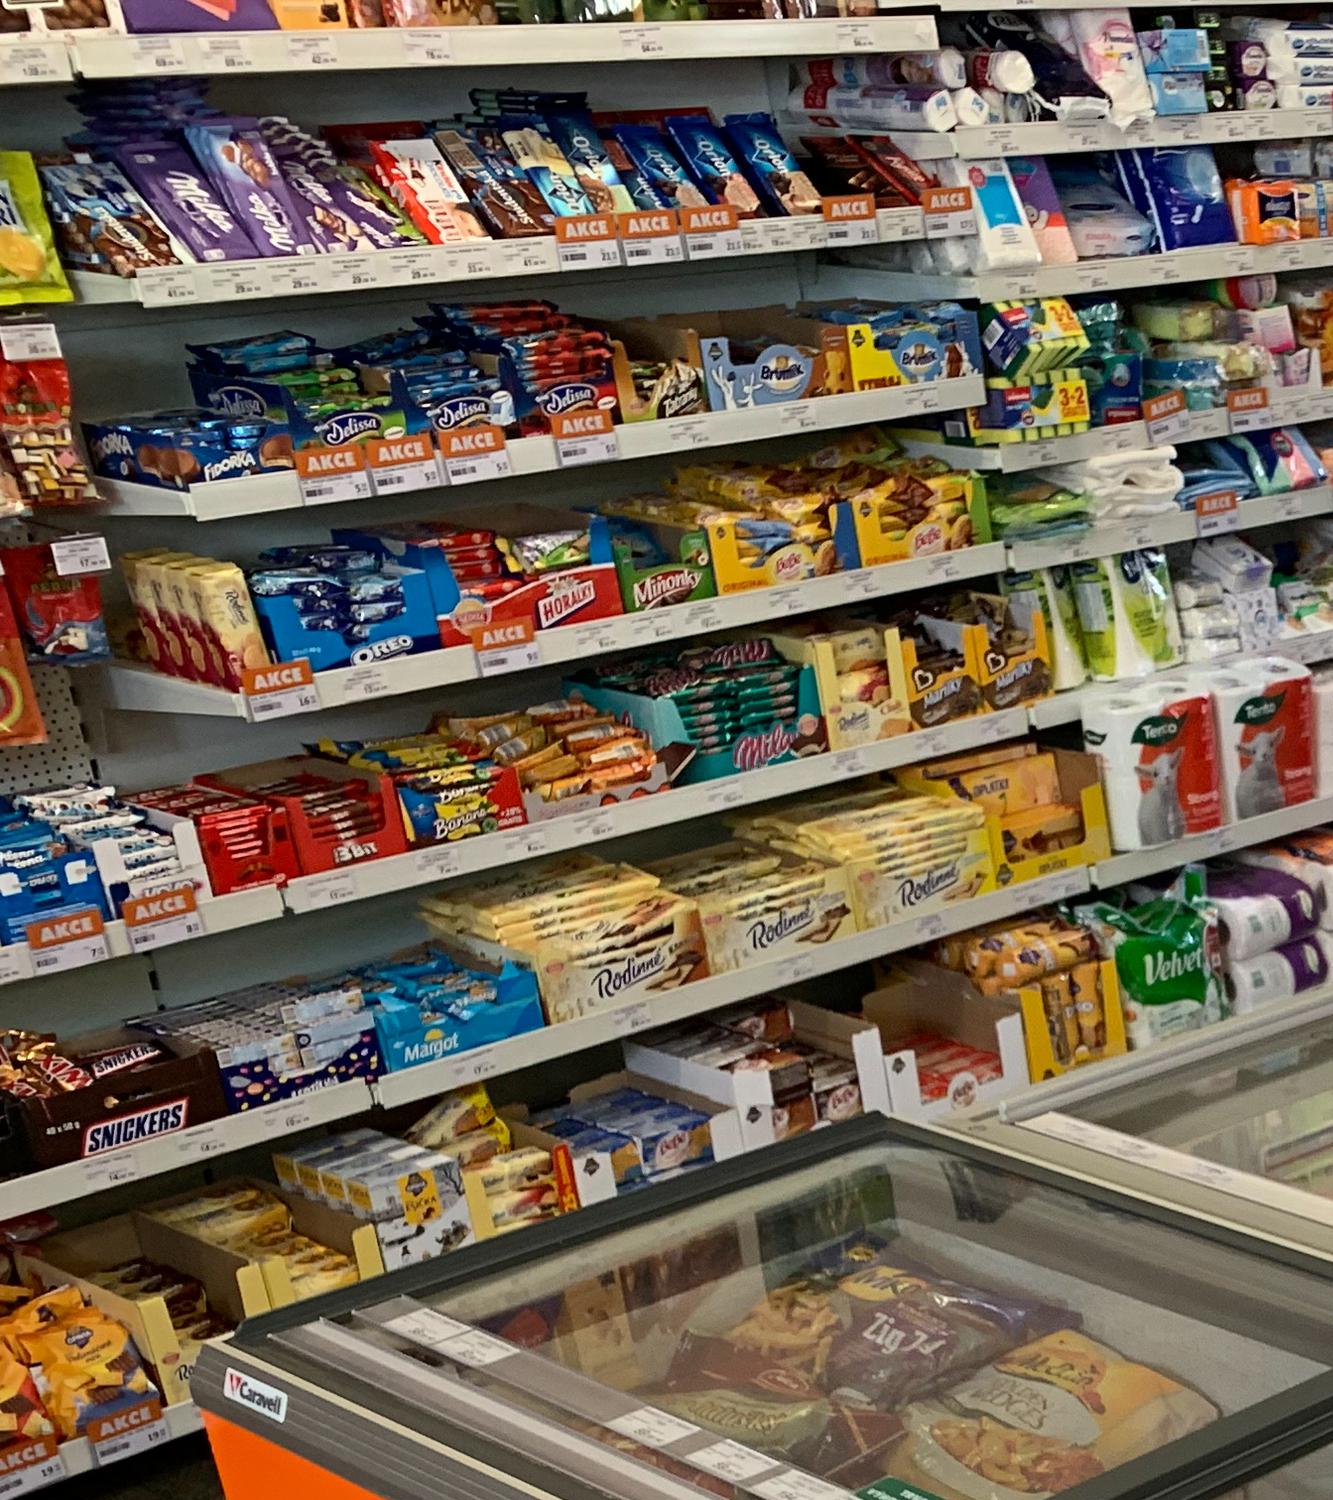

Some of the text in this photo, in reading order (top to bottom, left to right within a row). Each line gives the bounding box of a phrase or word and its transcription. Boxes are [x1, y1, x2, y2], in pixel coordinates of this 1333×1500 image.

[832, 201, 869, 218] AKCE
[930, 194, 967, 209] AKCE
[566, 221, 608, 239] AKCE
[628, 216, 670, 233] AKCE
[689, 211, 730, 228] AKCE
[438, 402, 487, 427] Delissa
[546, 389, 593, 415] Delissa
[326, 418, 378, 444] Delissa
[562, 415, 605, 434] AKCE
[378, 442, 426, 462] AKCE
[450, 432, 495, 452] AKCE
[203, 452, 256, 482] FIDORKA
[307, 453, 356, 472] AKCE
[633, 569, 703, 608] Miňonky
[482, 625, 525, 645] AKCE
[351, 634, 414, 665] OREO
[254, 667, 304, 690] AKCE
[135, 896, 187, 920] AKCE
[41, 917, 93, 942] AKCE
[592, 946, 667, 999] Rodinné
[1144, 949, 1203, 986] Velvet
[403, 1031, 460, 1065] Margot
[87, 1105, 184, 1154] SNICKERS
[239, 1382, 284, 1417] Caravell
[101, 1409, 152, 1437] AKCE
